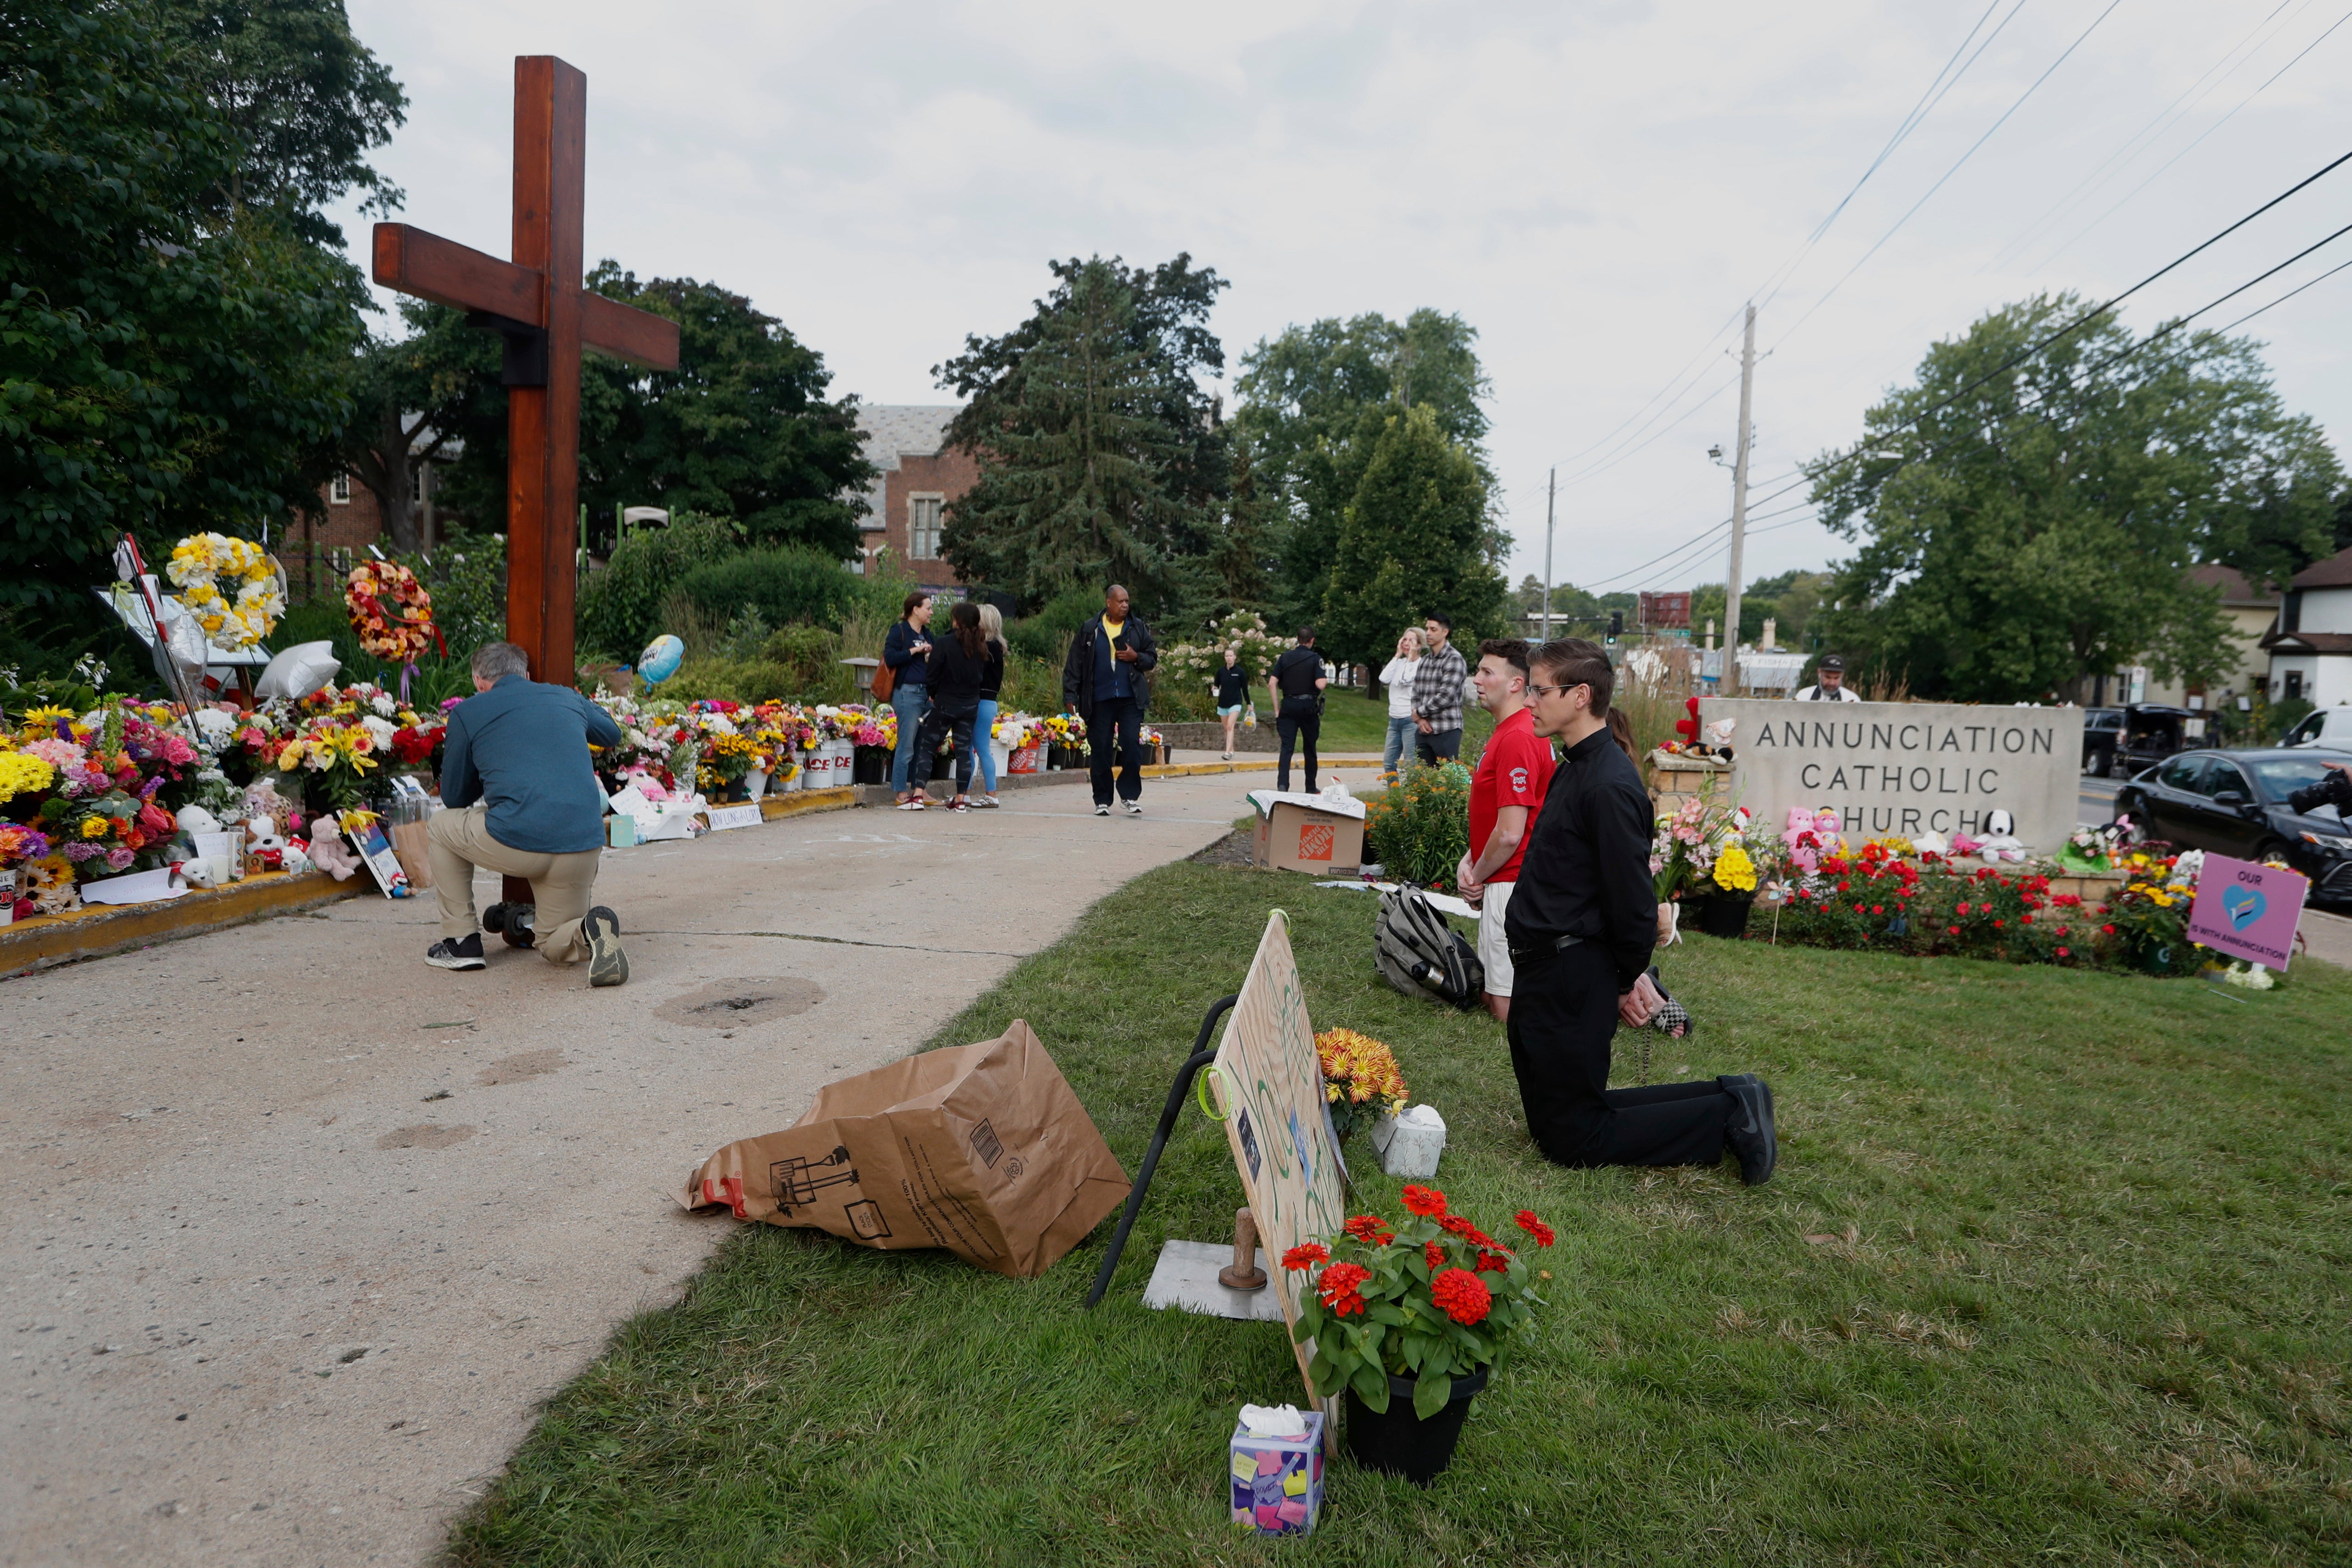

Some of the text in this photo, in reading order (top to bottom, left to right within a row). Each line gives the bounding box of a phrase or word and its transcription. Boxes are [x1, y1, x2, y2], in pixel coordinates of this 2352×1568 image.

[1755, 722, 2053, 755] ANNUNCIATION
[805, 757, 830, 771] ACE
[835, 756, 851, 767] CE
[1801, 764, 1999, 794] CATHOLIC
[709, 812, 723, 827] HOW
[723, 811, 739, 825] LONG
[1819, 806, 1979, 835] HURCH
[1299, 826, 1334, 859] HOME
[1300, 825, 1321, 846] DEPOT
[1315, 843, 1329, 857] THE
[2238, 871, 2263, 886] OUR
[2200, 927, 2221, 940] WITH
[2221, 934, 2286, 960] ANNUNCIATION
[900, 1179, 910, 1197] 100%
[922, 1184, 933, 1201] RULES
[911, 1206, 923, 1221] made
[926, 1217, 949, 1245] Recyclable
[926, 1227, 935, 1237] bag
[952, 1228, 963, 1240] YOUR
